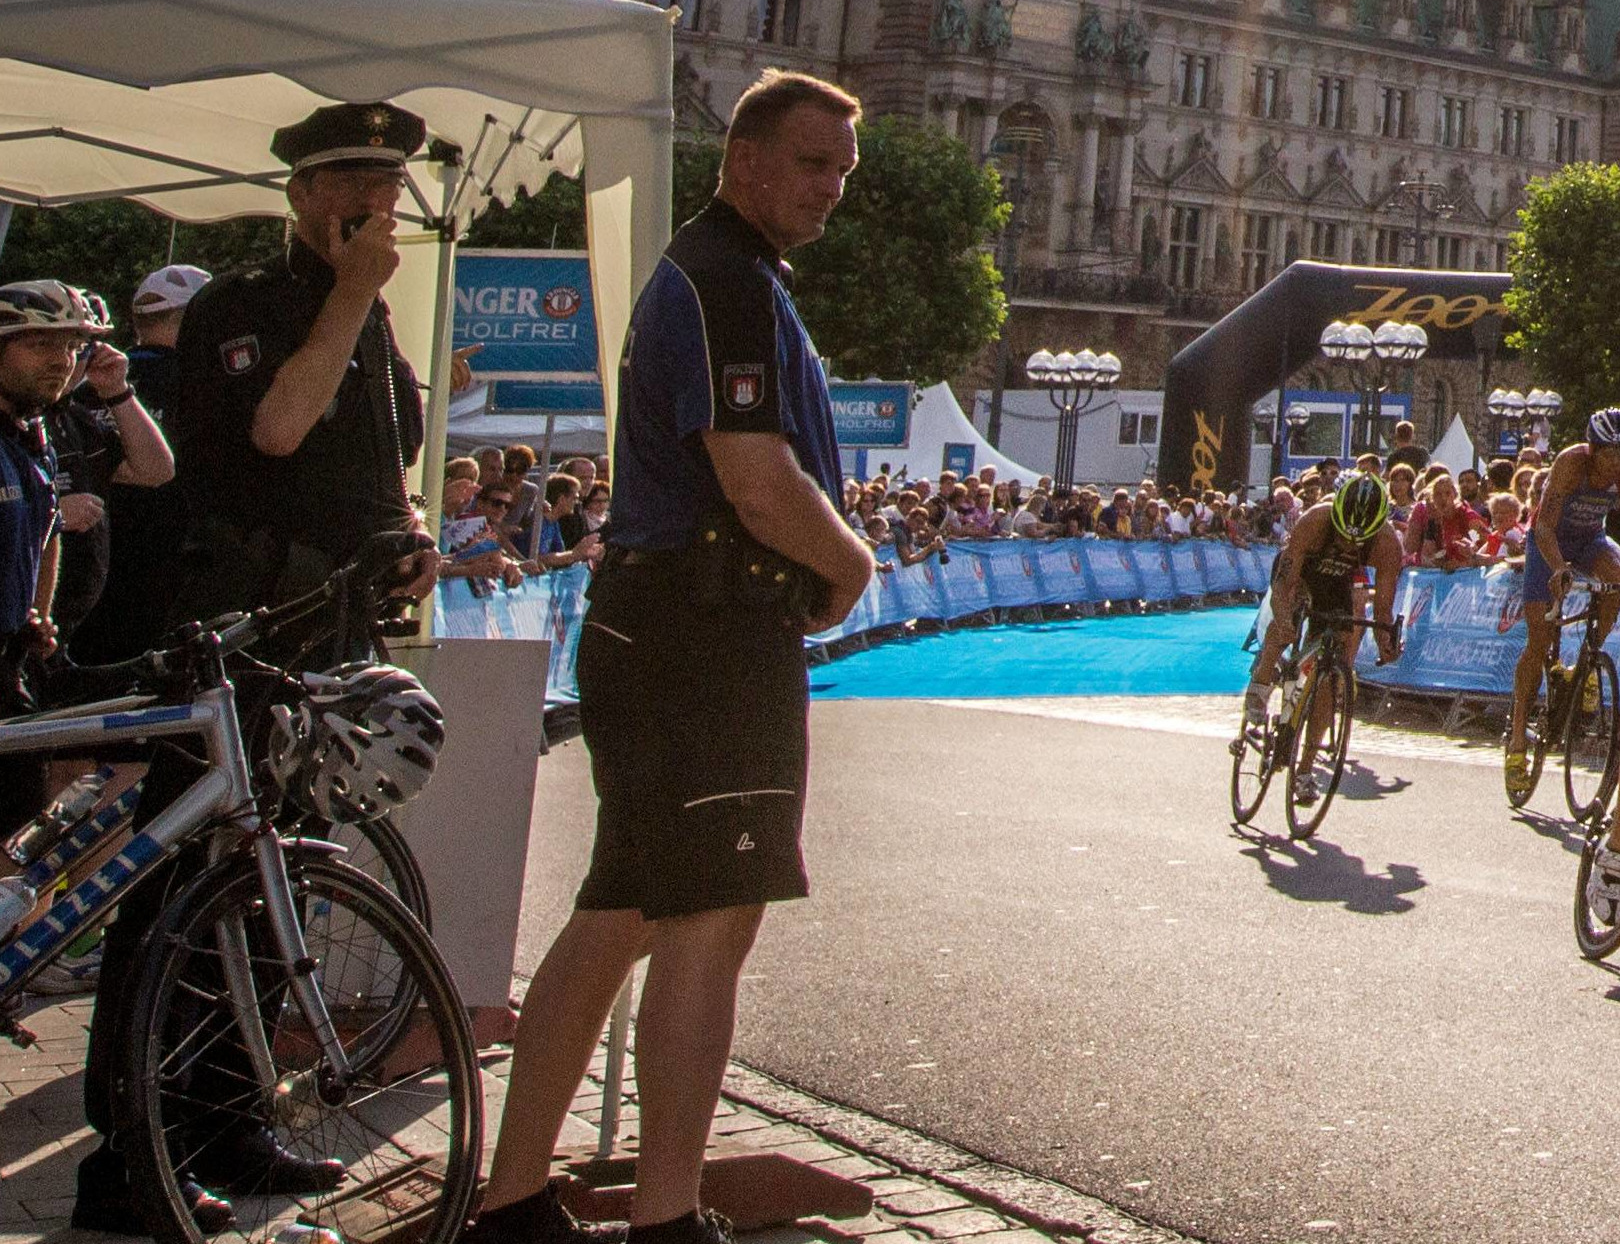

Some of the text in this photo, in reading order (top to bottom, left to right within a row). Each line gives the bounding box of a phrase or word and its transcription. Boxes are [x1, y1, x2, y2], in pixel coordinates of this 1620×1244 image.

[454, 287, 540, 318] NGER
[1347, 284, 1509, 329] Zoo
[453, 321, 578, 340] HOLFREI
[833, 400, 879, 417] INGER
[835, 418, 897, 429] HOLFREI
[0, 852, 139, 986] OLIZEI
